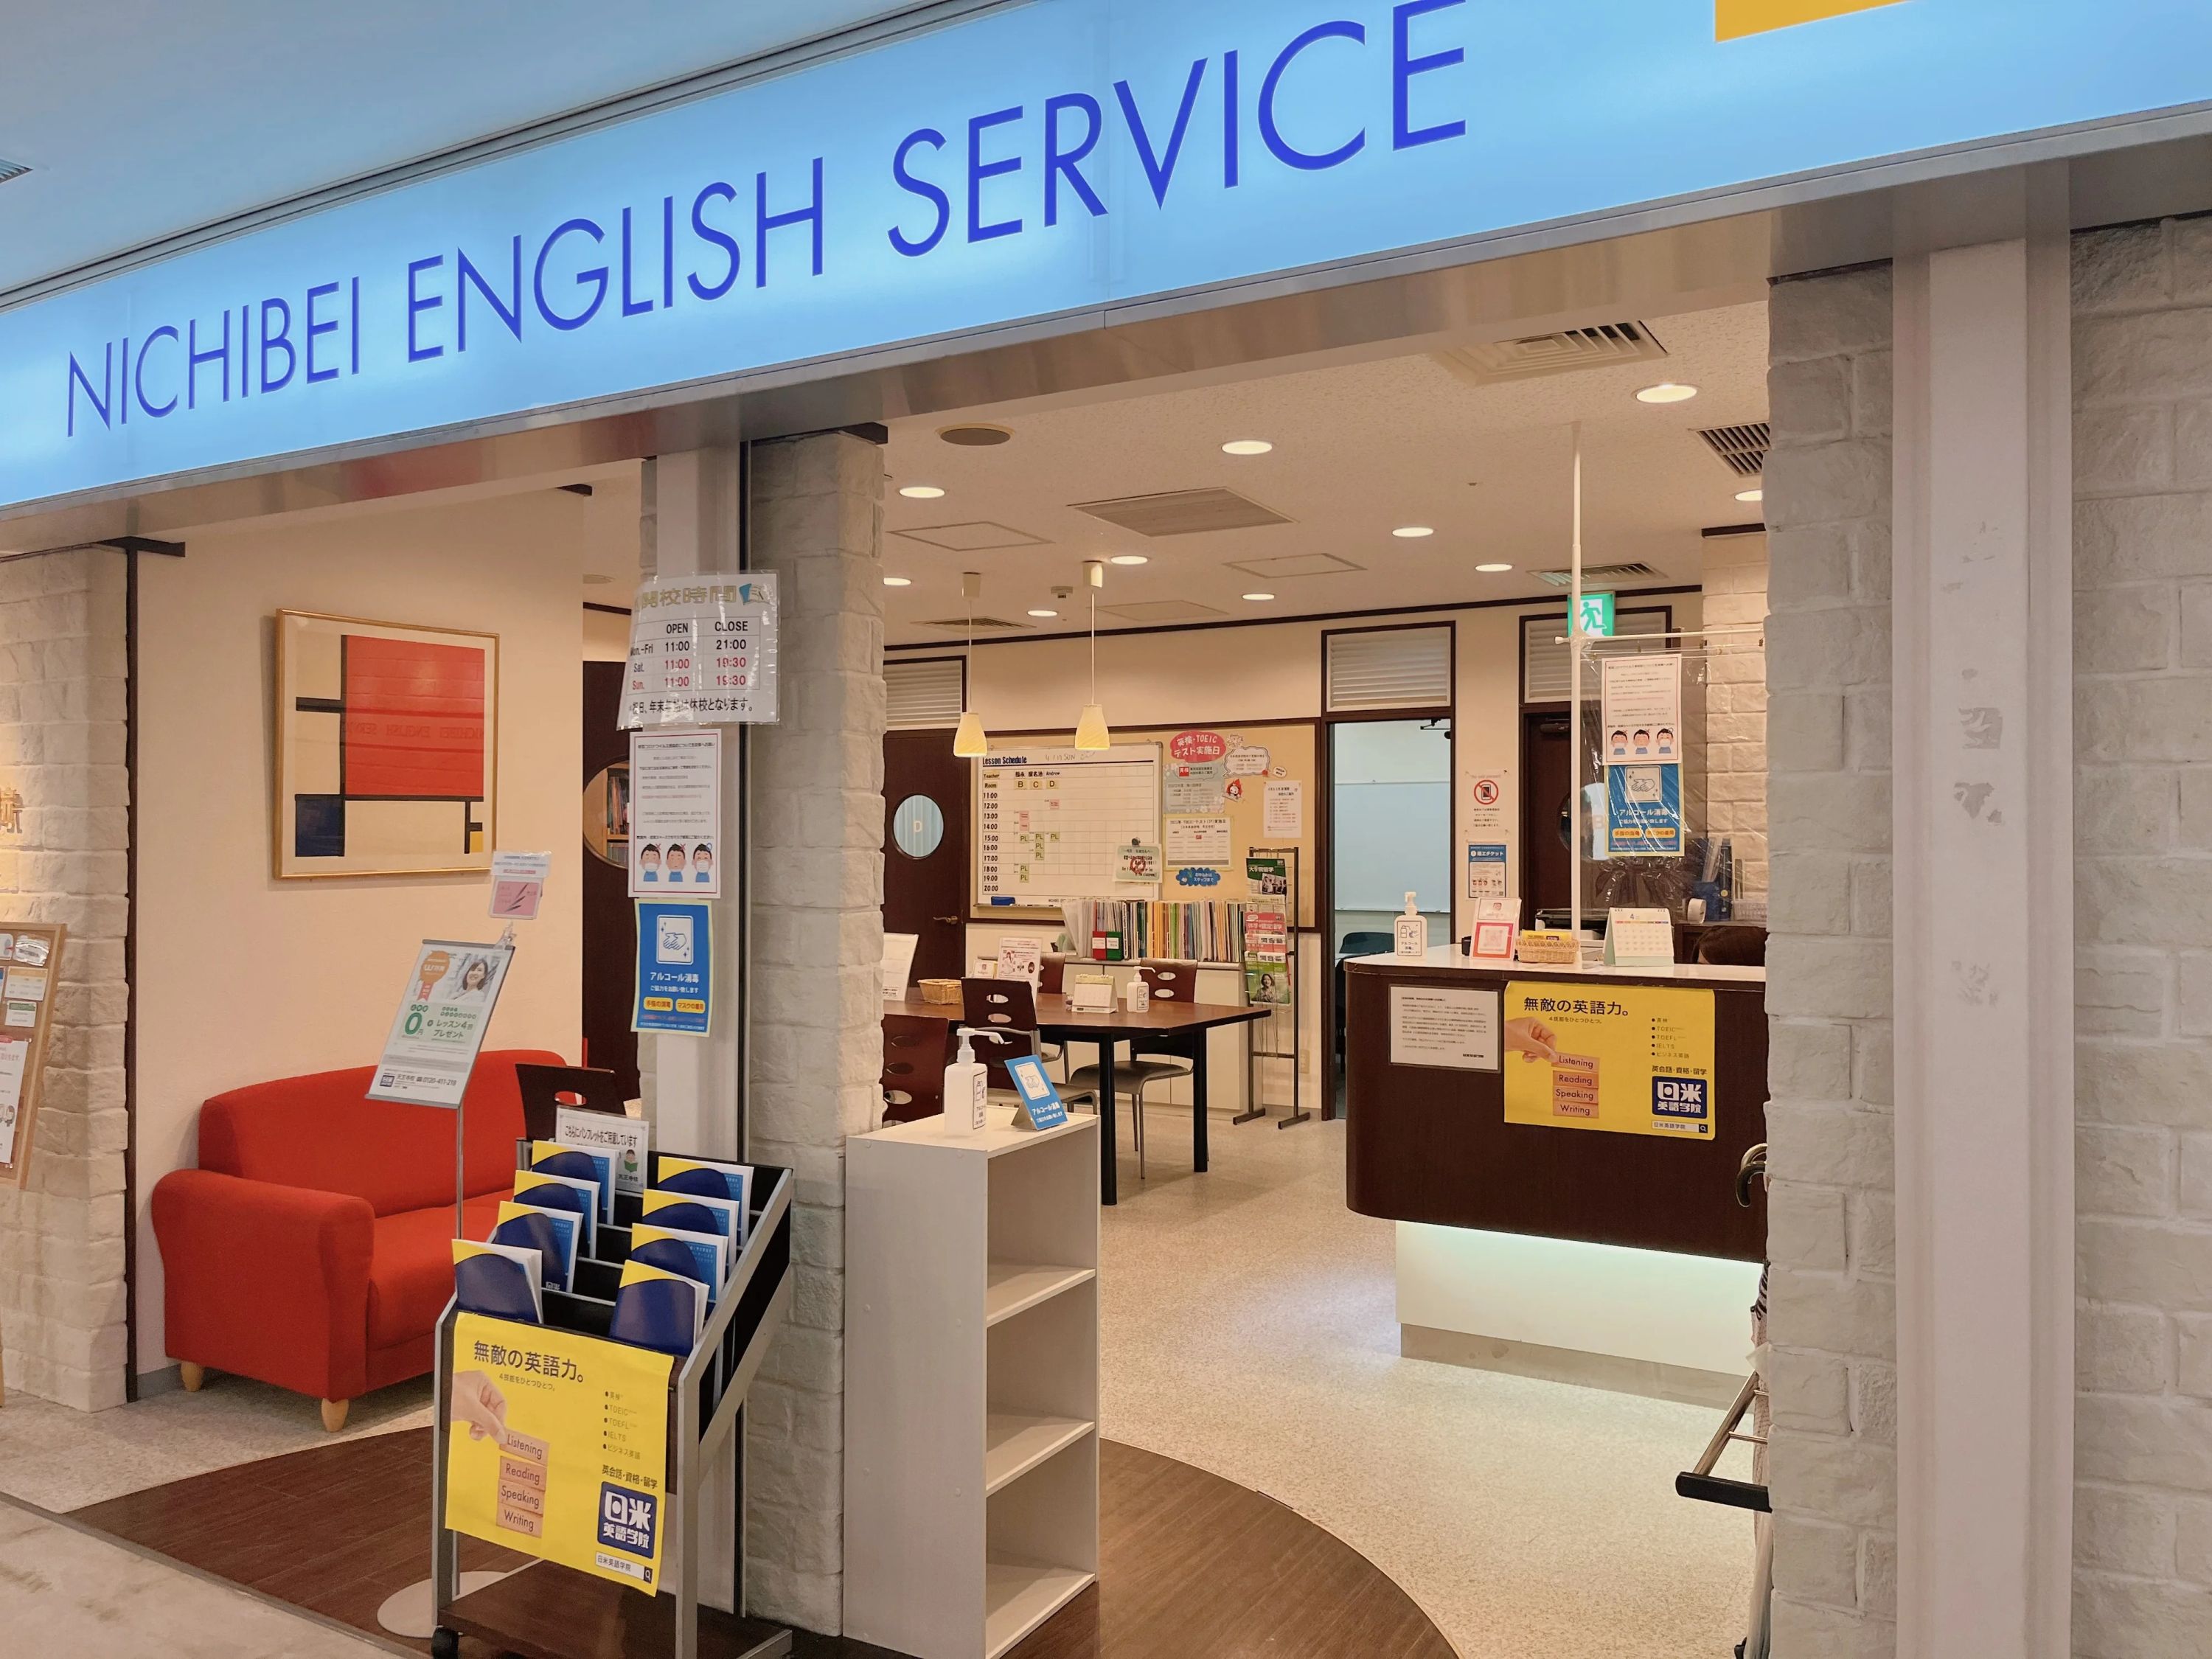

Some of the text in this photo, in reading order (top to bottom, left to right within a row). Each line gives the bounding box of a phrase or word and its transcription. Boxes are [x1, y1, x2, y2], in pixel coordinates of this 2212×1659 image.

[68, 0, 1467, 437] NICHIBEI ENGLISH SERVICE
[666, 621, 748, 634] OPEN CLOSE
[665, 640, 690, 653] 11:00
[716, 639, 747, 650] 21:00
[665, 658, 690, 669] 11:00
[716, 656, 747, 668] 19:30
[664, 675, 690, 688] 11:00
[716, 675, 747, 686] 19:30
[1174, 746, 1220, 758] テスト実施日
[983, 755, 1027, 765] Lesson Schedule
[1618, 808, 1669, 816] アルコール消毒
[650, 972, 700, 984] アルコール消毒
[1523, 997, 1628, 1016] 無敵の英語力。
[434, 1029, 464, 1039] プレゼント
[1559, 1055, 1593, 1069] Listening
[1652, 1065, 1708, 1075] 英会話・資格・留学
[1559, 1074, 1593, 1086] Reading
[1555, 1088, 1594, 1102] Speaking
[1657, 1081, 1702, 1102] 日米
[1560, 1104, 1590, 1116] Writing
[1657, 1100, 1703, 1114] 英語学院
[474, 1340, 584, 1383] 無敵の英語力。
[608, 1432, 627, 1442] IELTS
[507, 1433, 543, 1460] Listening
[506, 1463, 540, 1486] Reading
[602, 1464, 658, 1489] 英会話・資格・留学
[501, 1485, 540, 1510] Speaking
[604, 1491, 652, 1531] 日米
[504, 1509, 535, 1533] Writing
[602, 1522, 650, 1549] 英語学院
